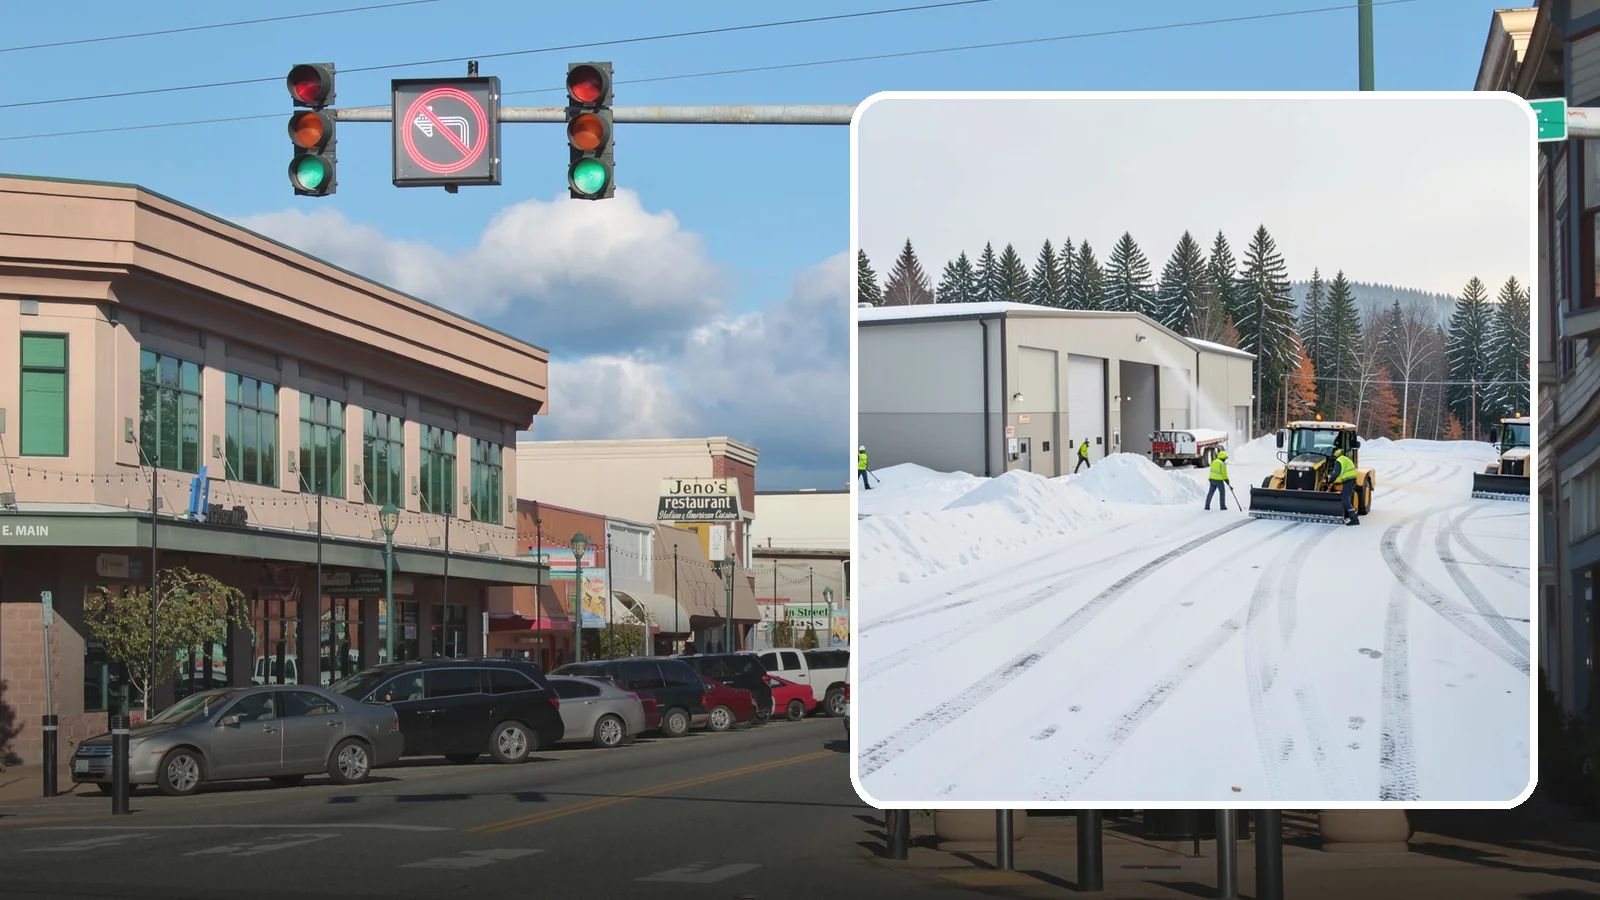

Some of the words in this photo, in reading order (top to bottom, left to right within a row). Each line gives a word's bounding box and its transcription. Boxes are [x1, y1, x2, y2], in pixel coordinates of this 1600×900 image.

[670, 480, 727, 494] Jeno's
[665, 496, 731, 509] restaurant
[686, 510, 714, 520] American
[715, 509, 737, 519] Cuisine
[2, 525, 13, 536] E.
[15, 525, 49, 536] MAIN
[797, 607, 828, 617] Street
[790, 619, 824, 627] lass
